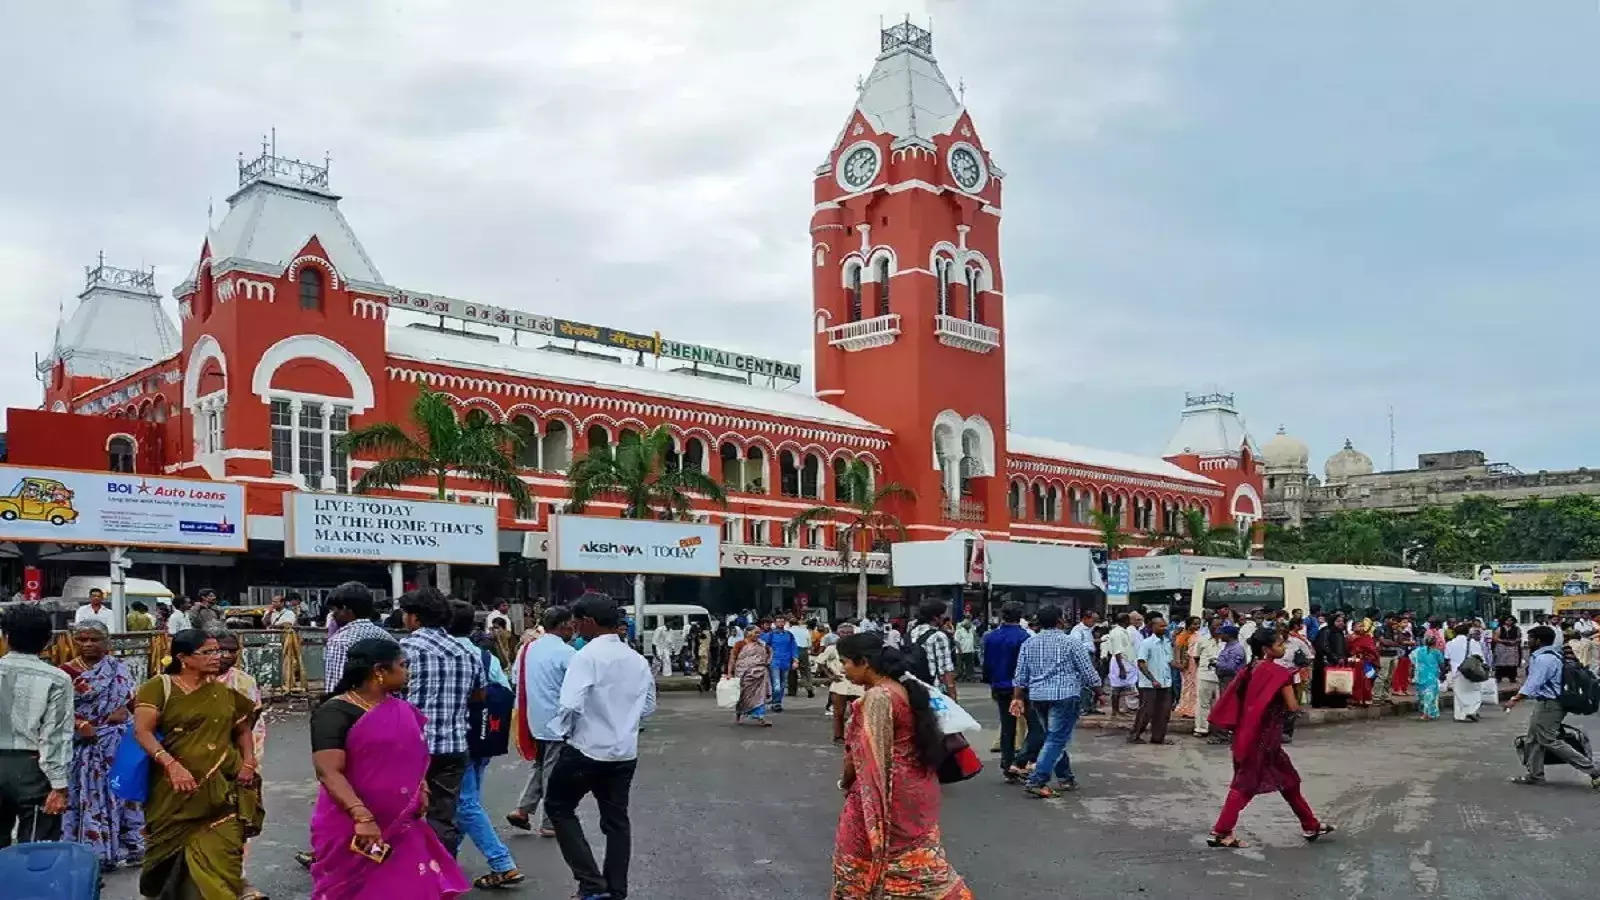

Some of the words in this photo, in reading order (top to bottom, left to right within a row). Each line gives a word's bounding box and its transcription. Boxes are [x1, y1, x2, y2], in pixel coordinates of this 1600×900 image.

[660, 341, 730, 365] CHENNAI
[735, 356, 800, 379] CENTRAL
[107, 482, 132, 494] BOI
[154, 486, 186, 498] Auto
[189, 489, 226, 500] Loans
[314, 499, 354, 512] LIVE
[357, 502, 414, 516] TODAY
[315, 515, 333, 525] IN
[337, 516, 373, 529] THE
[377, 518, 427, 533] HOME
[430, 521, 484, 536] THAT'S
[315, 529, 385, 544] MAKING
[651, 545, 696, 559] TODAY
